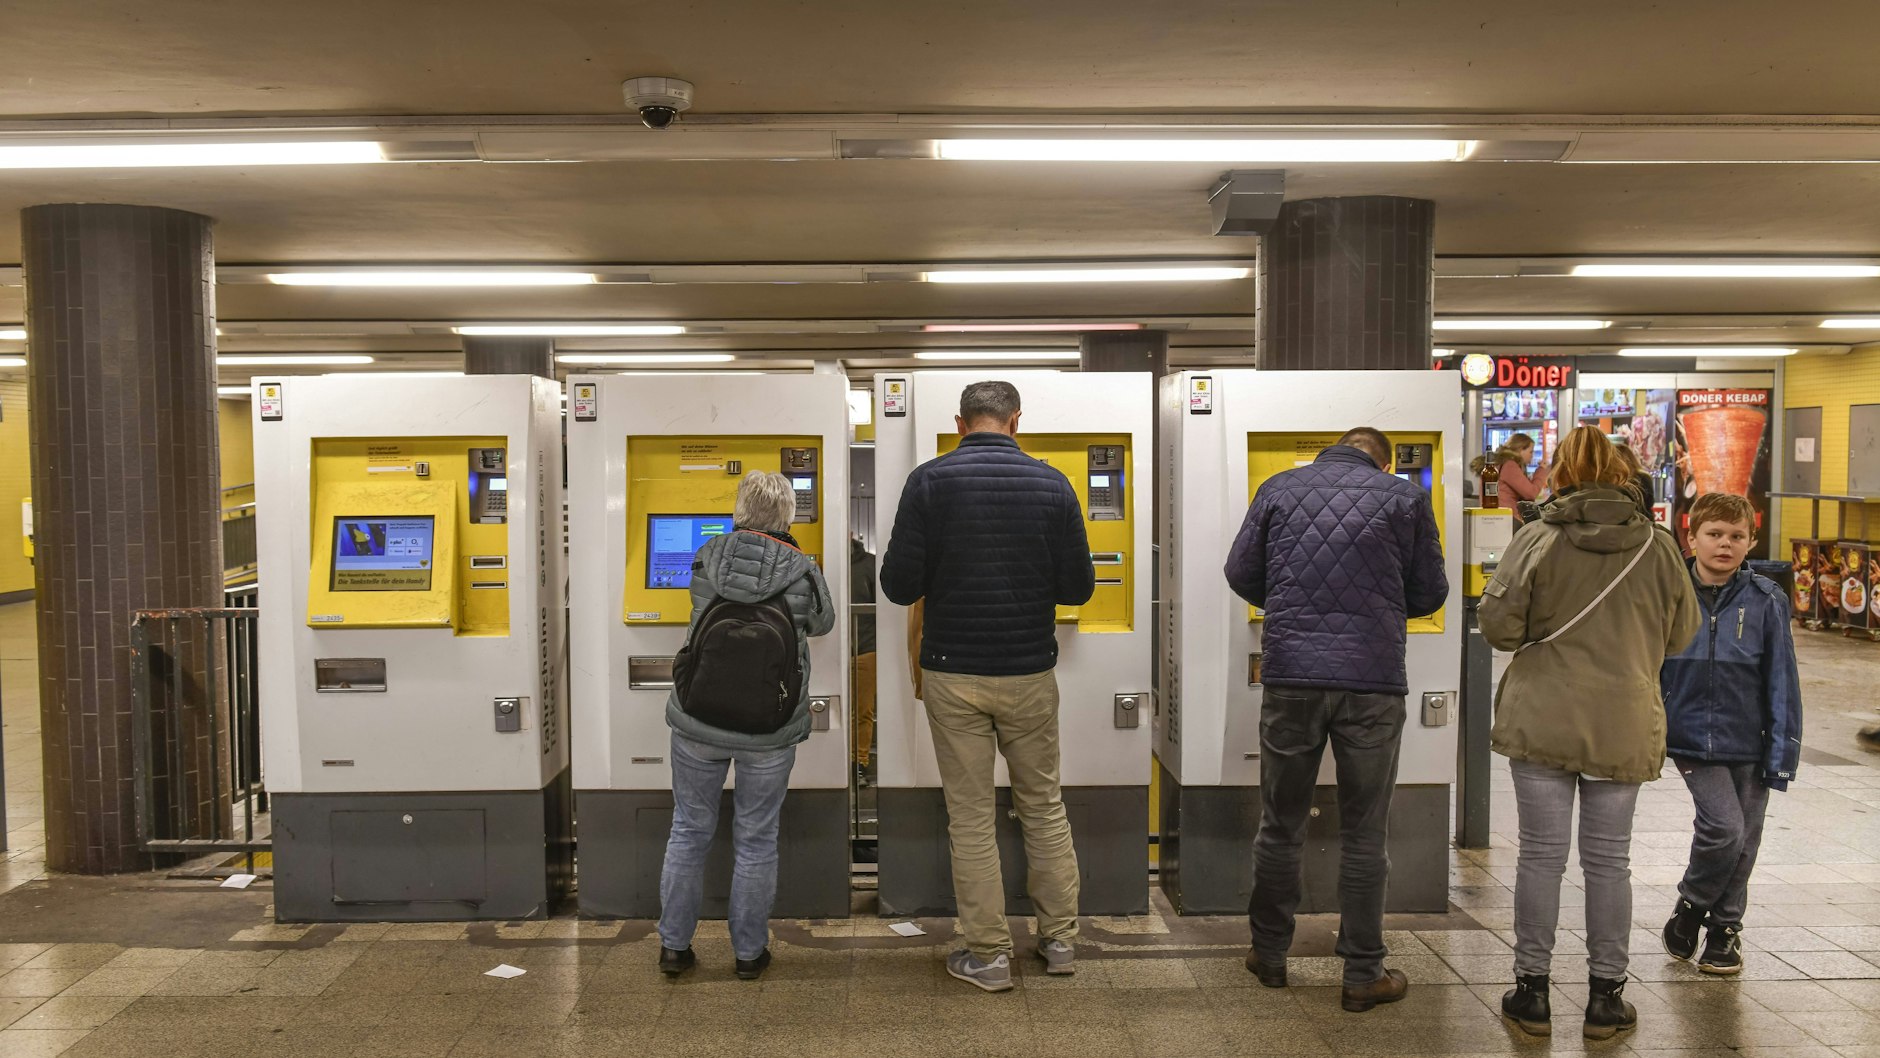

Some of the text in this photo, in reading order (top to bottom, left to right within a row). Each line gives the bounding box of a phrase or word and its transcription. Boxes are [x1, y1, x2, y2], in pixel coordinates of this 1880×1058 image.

[1497, 358, 1571, 387] Döner
[1726, 393, 1766, 403] KEBAP
[405, 578, 426, 586] Handy
[540, 607, 550, 755] Fahrscheine
[549, 665, 557, 748] Tickets
